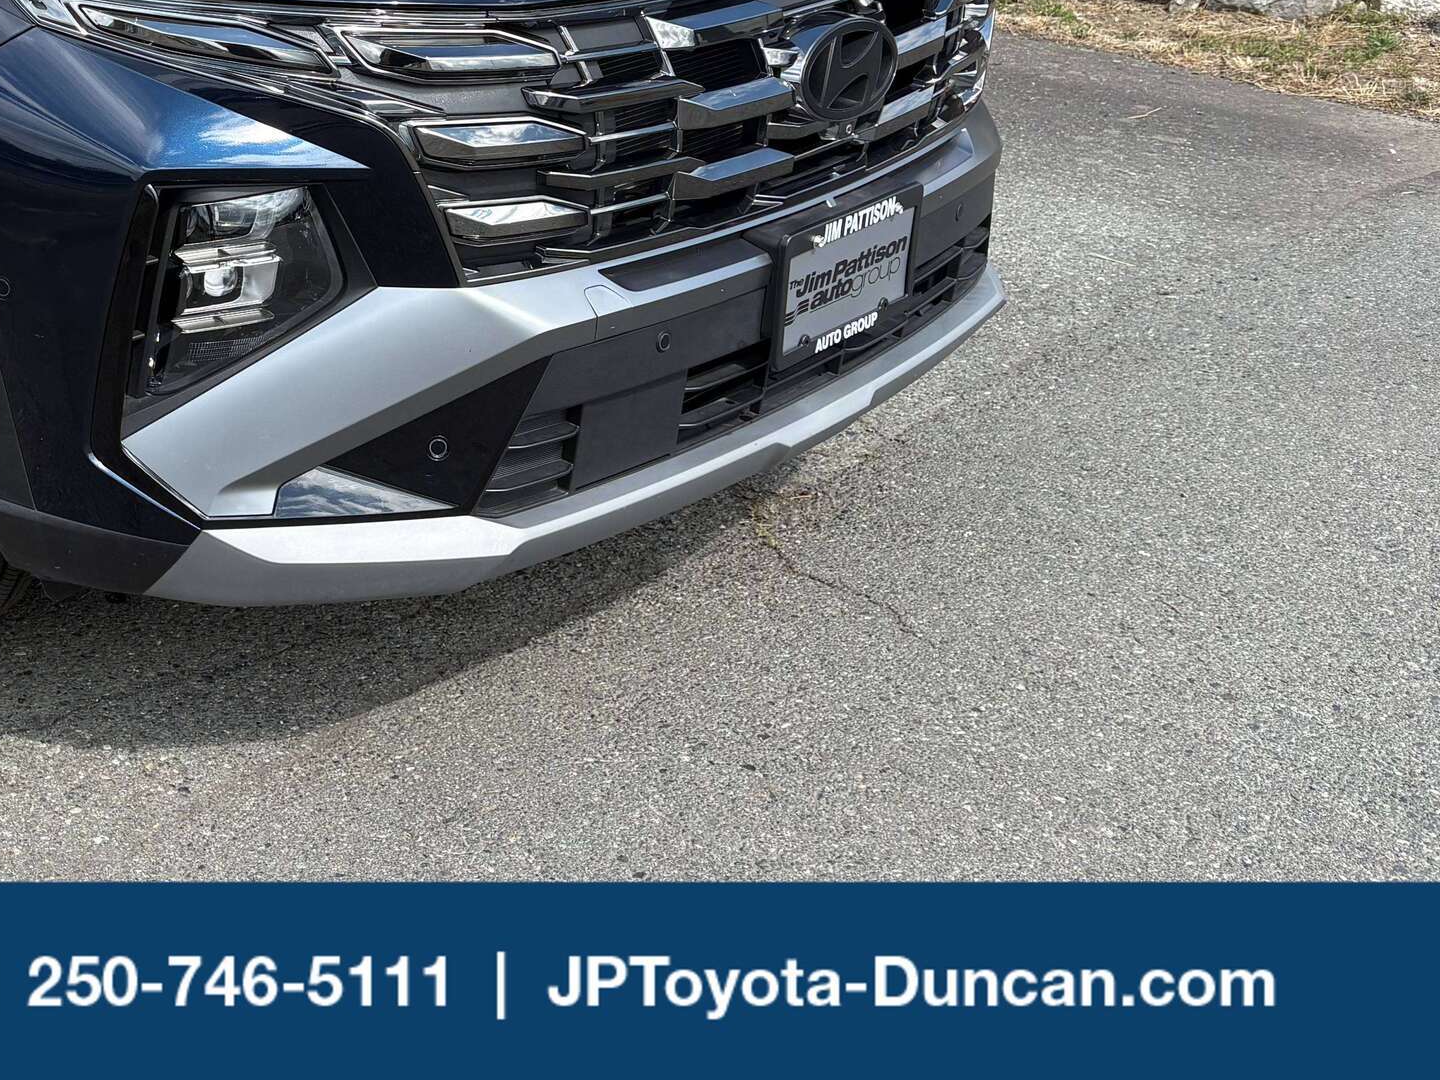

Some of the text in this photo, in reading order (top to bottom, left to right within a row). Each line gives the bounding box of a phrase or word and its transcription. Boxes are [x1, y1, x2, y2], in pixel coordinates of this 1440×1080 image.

[822, 196, 897, 245] JIM PATTISON
[814, 311, 878, 354] AUTO GROUP
